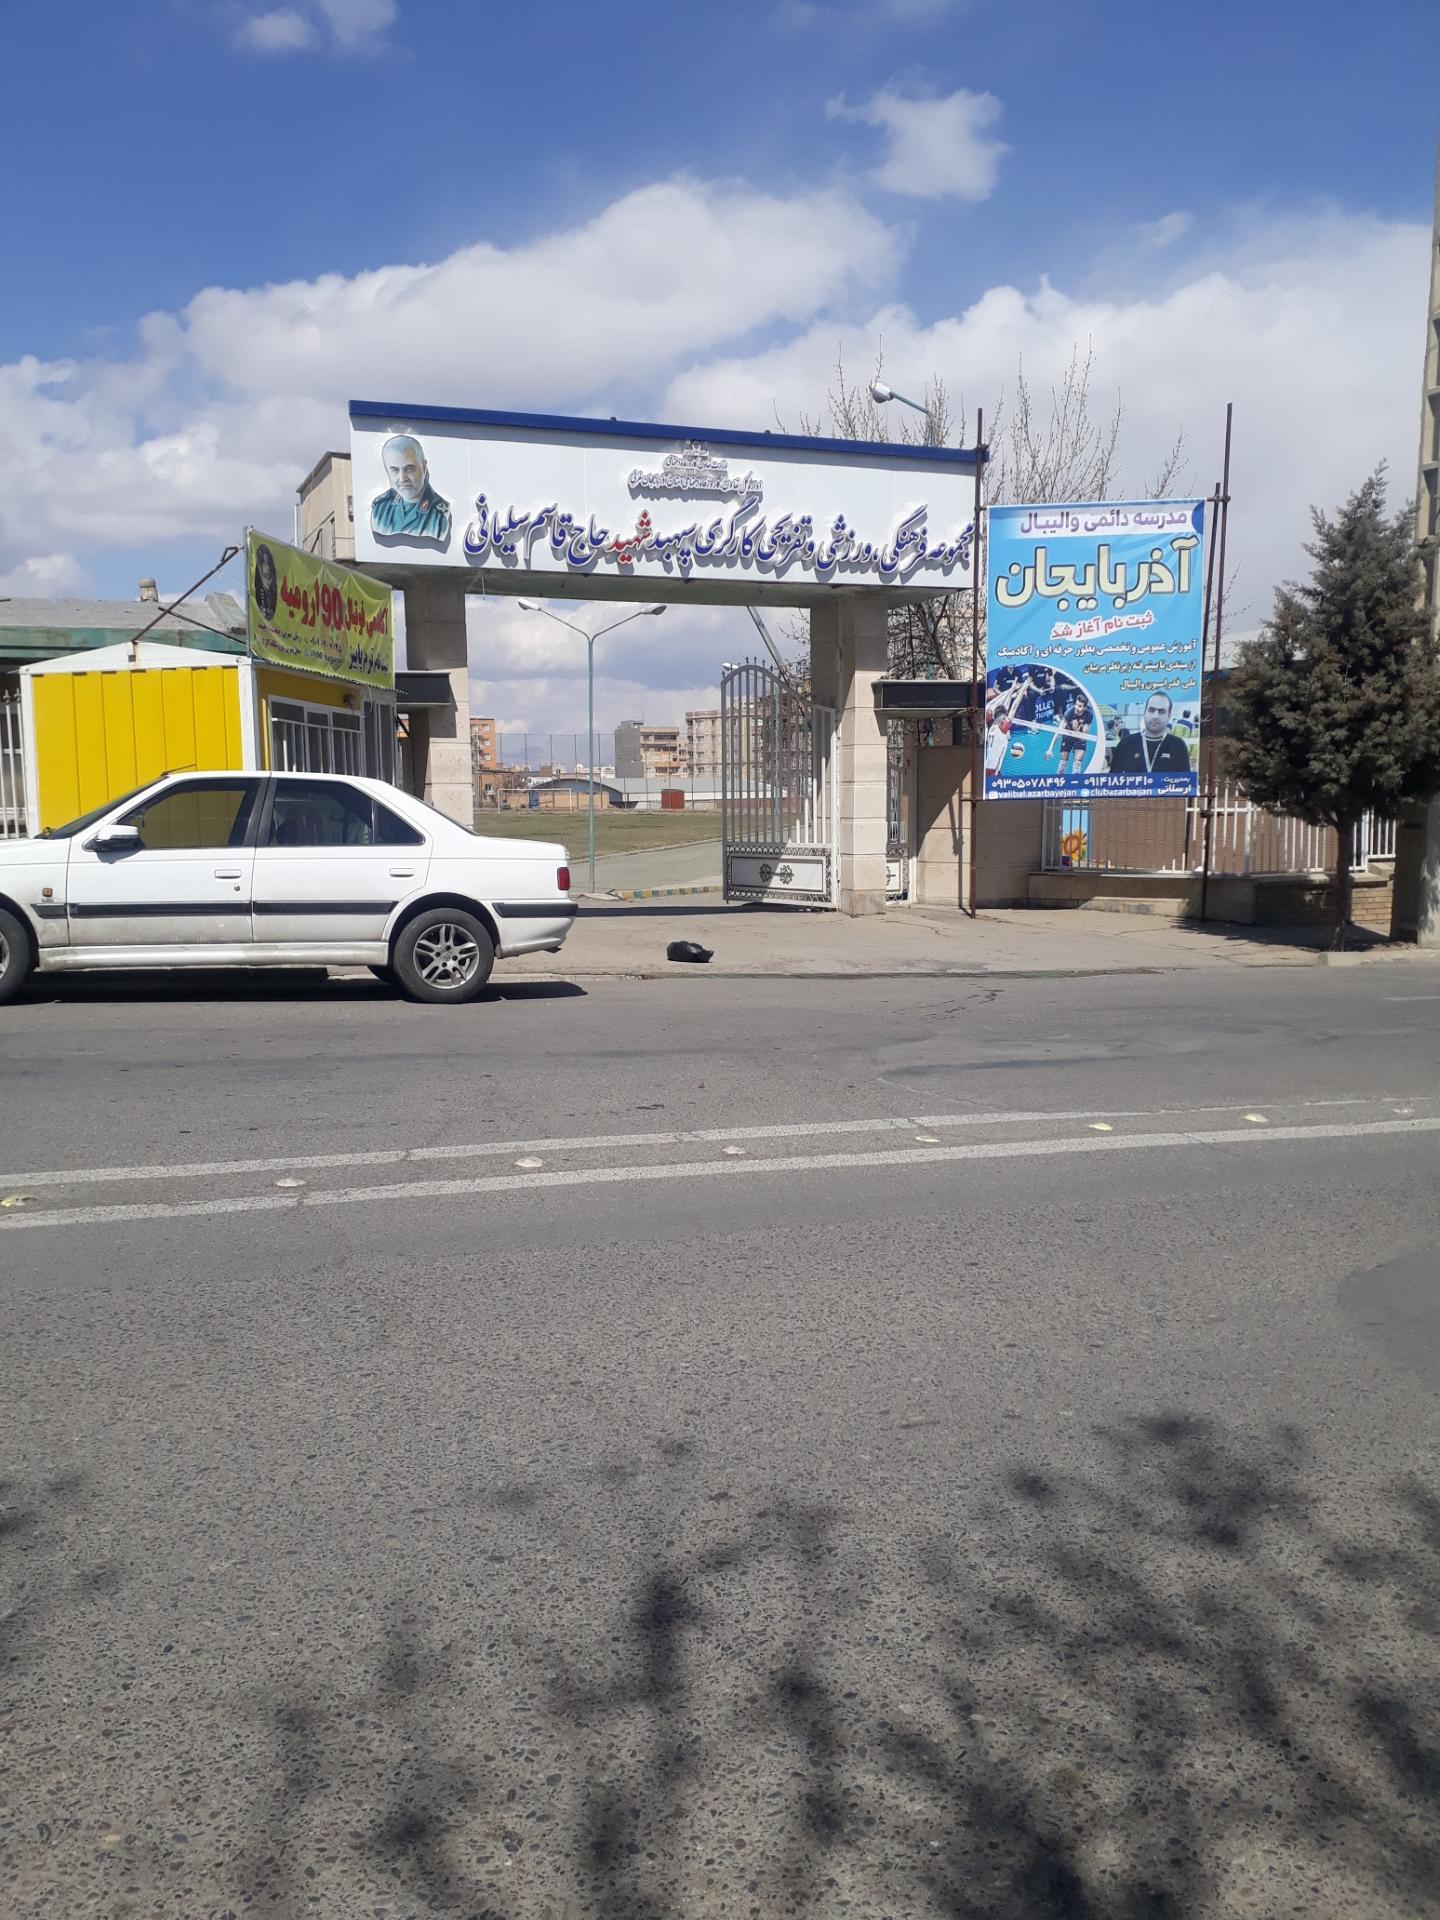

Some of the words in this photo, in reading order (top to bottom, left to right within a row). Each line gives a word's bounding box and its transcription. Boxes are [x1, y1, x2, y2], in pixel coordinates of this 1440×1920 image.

[464, 493, 531, 554] سلیمانی
[694, 496, 767, 556] کارگری
[1020, 511, 1080, 534] والیبال
[1084, 509, 1129, 531] دائمی
[1132, 511, 1188, 530] مدرسه
[524, 503, 573, 560] قاسم
[566, 513, 610, 566] حاج
[606, 509, 653, 565] شهید
[757, 512, 813, 567] تفریحی
[648, 522, 697, 566] سپهبد
[928, 522, 975, 566] مجموعه
[995, 534, 1200, 612] آذربایجان
[280, 574, 321, 628] ارومیه
[321, 582, 344, 632] 90
[1051, 624, 1073, 639] شد
[1075, 618, 1101, 638] آغاز
[1104, 617, 1123, 634] نام
[1126, 612, 1153, 629] ثبت
[997, 643, 1033, 658] آکادمیک
[1053, 644, 1074, 657] حرفه
[1137, 643, 1166, 654] عمومی
[1166, 640, 1197, 653] آموزش
[1120, 678, 1146, 691] والیبال
[1157, 783, 1192, 795] ارسلانی
